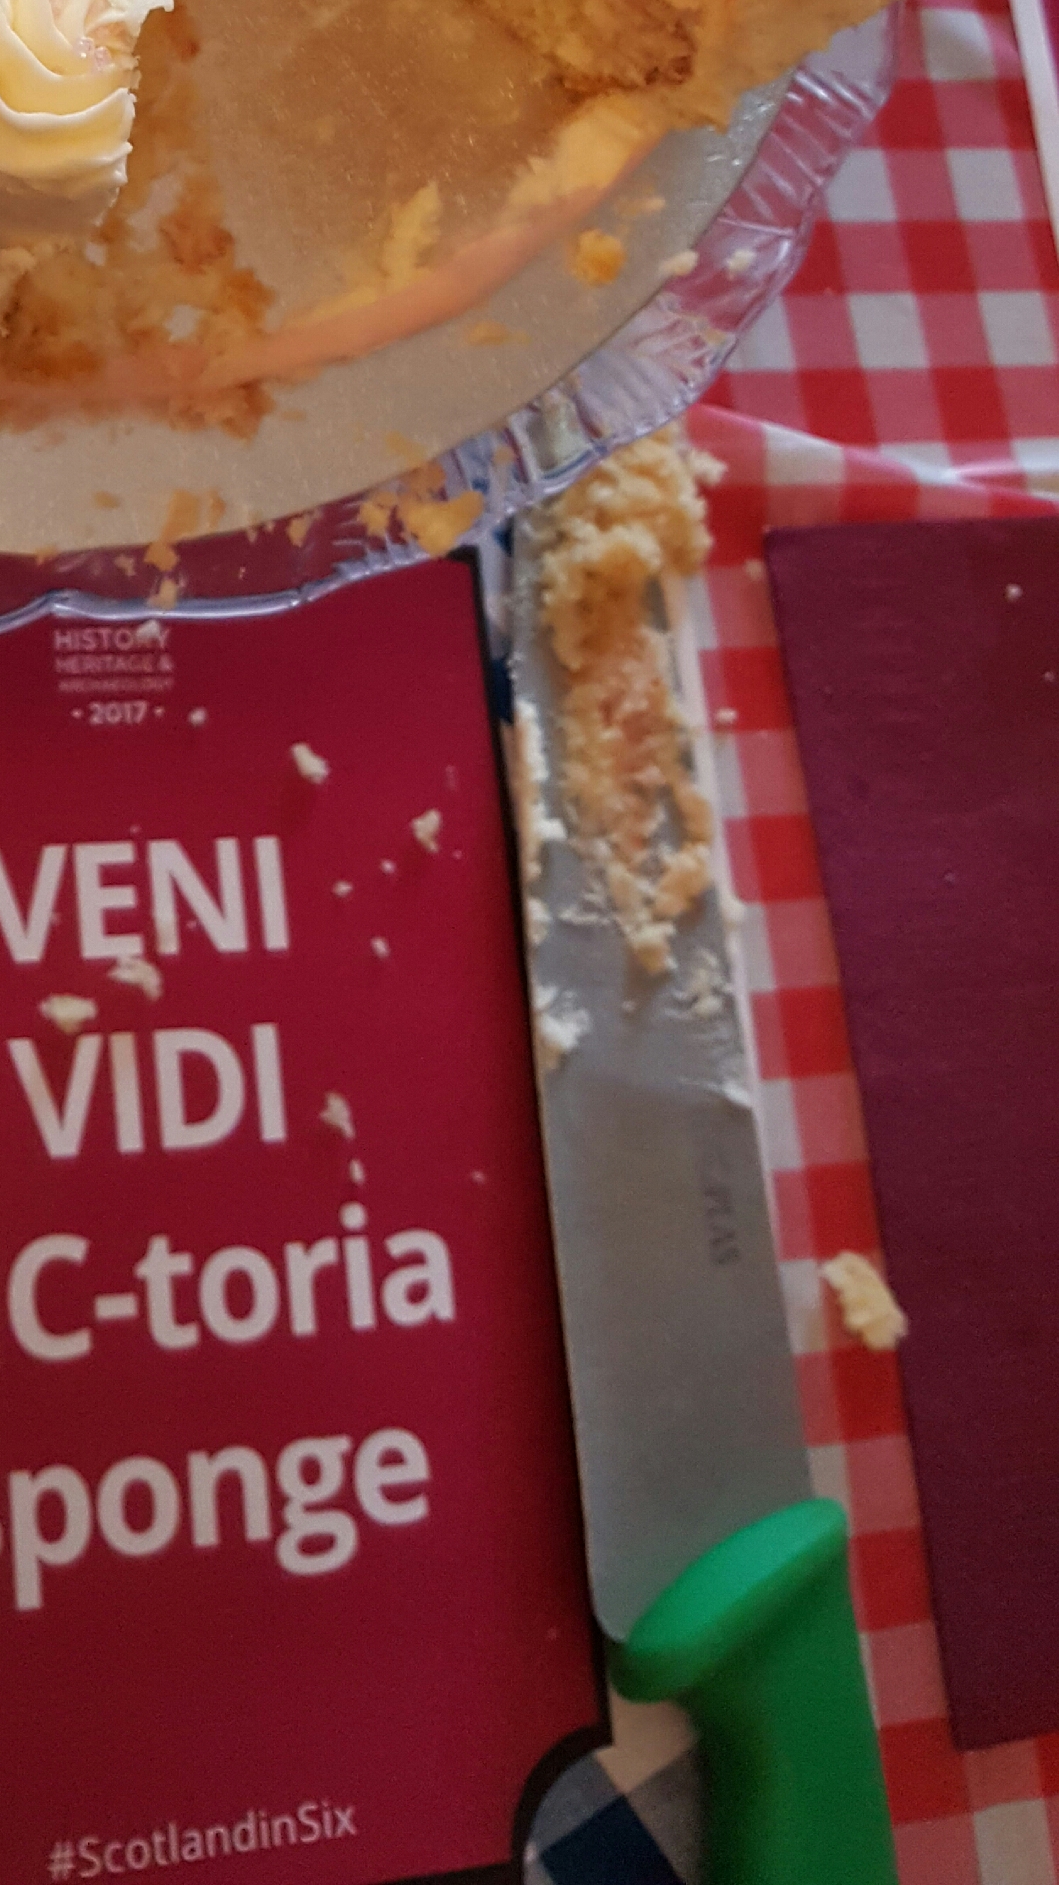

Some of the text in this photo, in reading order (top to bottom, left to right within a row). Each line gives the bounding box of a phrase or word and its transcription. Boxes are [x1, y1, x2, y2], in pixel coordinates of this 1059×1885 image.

[88, 700, 148, 724] 2017
[7, 1023, 286, 1158] VIDI
[46, 1798, 358, 1881] #ScotlandinSix
